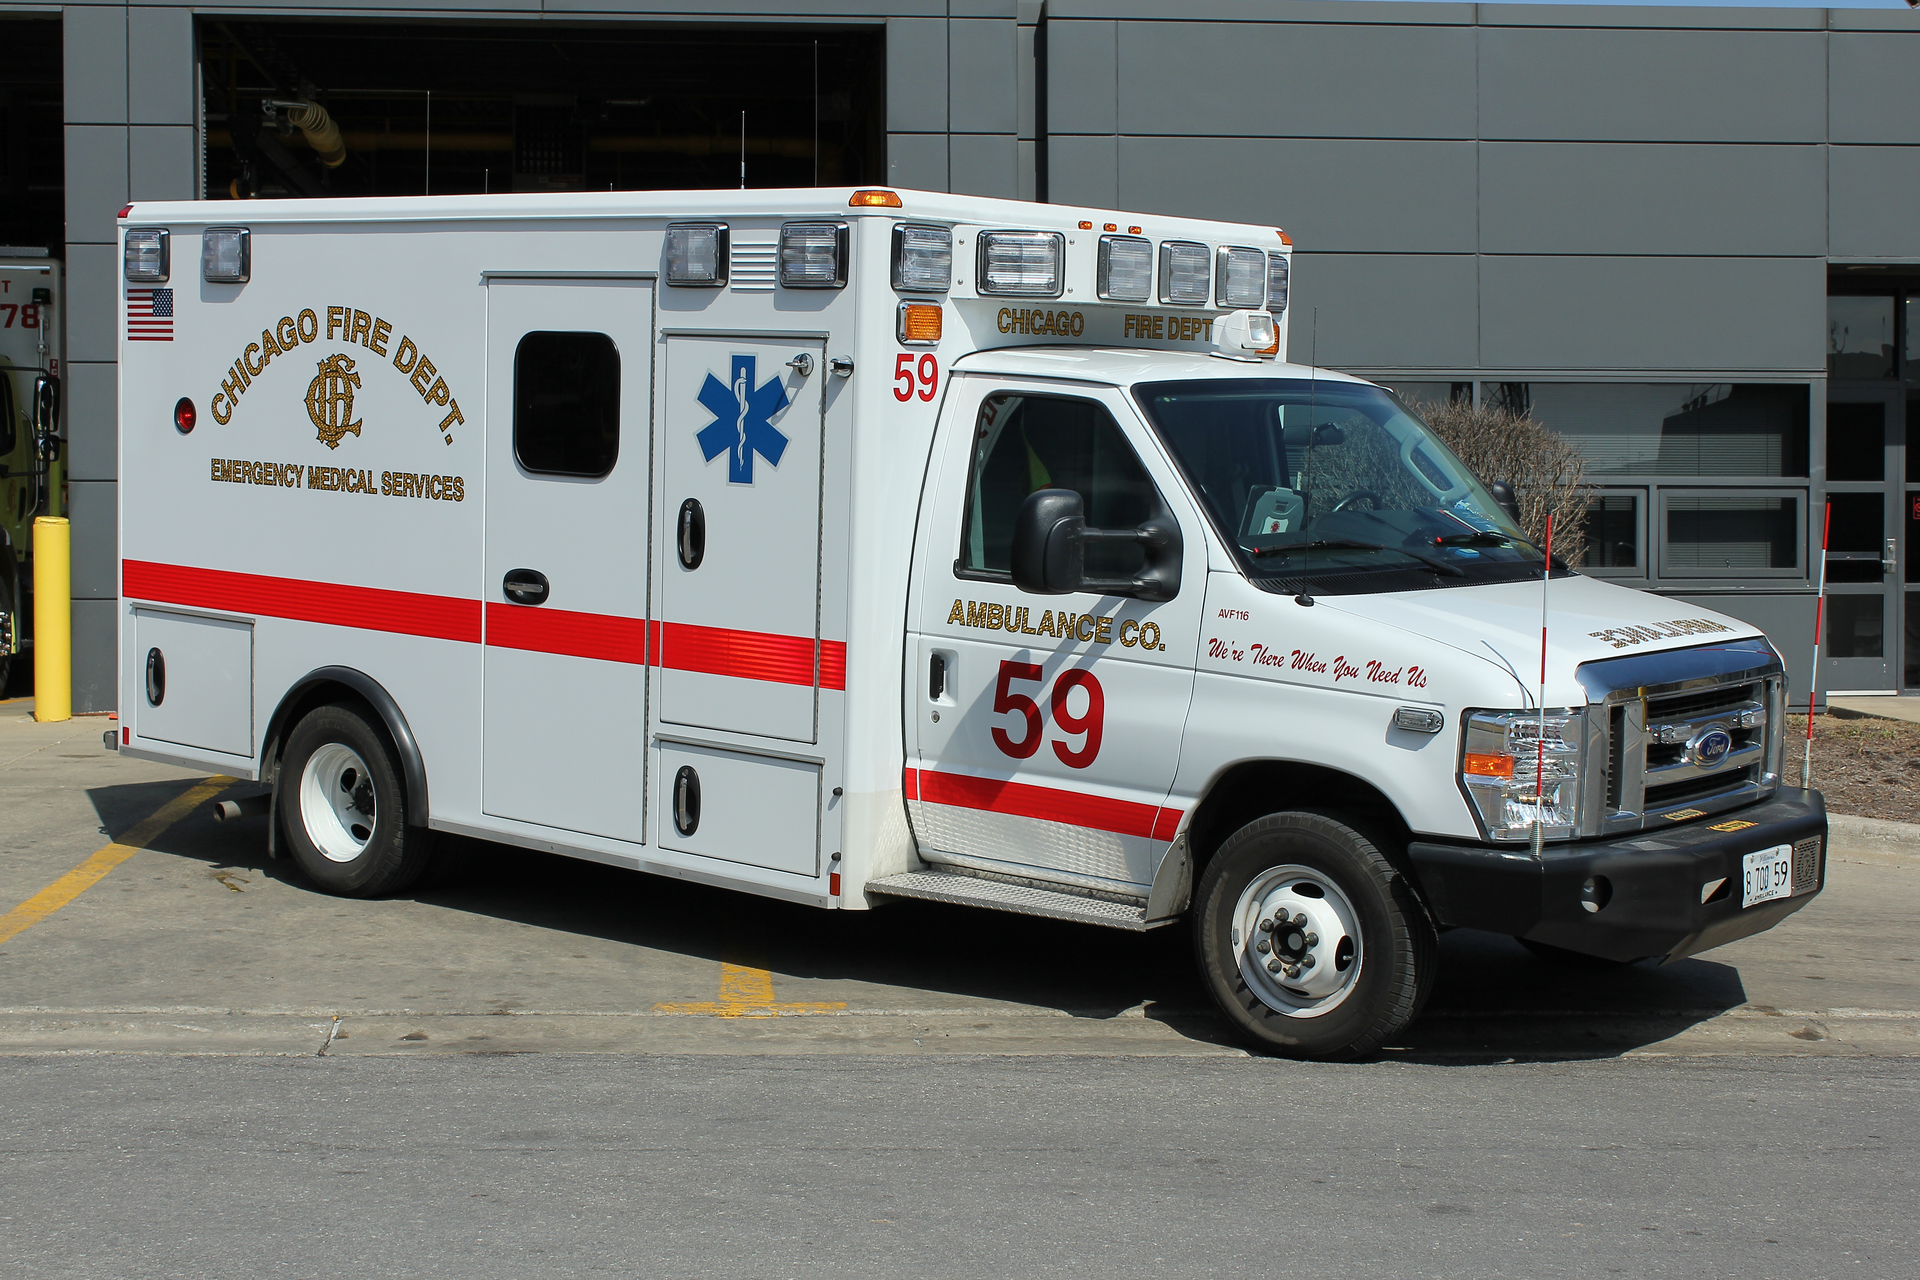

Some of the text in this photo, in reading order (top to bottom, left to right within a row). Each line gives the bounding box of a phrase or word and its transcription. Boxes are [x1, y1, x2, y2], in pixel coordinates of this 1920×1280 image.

[997, 308, 1084, 337] CHICAGO
[1124, 314, 1162, 339] FIRE
[211, 306, 465, 446] CHICAGO FIRE DEPT.
[893, 353, 939, 402] 59
[211, 458, 464, 502] EMERGENCY MEDICAL SERVICES
[947, 599, 1165, 651] AMBULANCE CO.
[1218, 608, 1249, 621] AVF116
[1208, 638, 1427, 688] We're There When You Need Us
[991, 660, 1105, 769] 59
[1706, 736, 1726, 756] Ford
[1746, 871, 1751, 895] 8
[1774, 861, 1787, 886] 59
